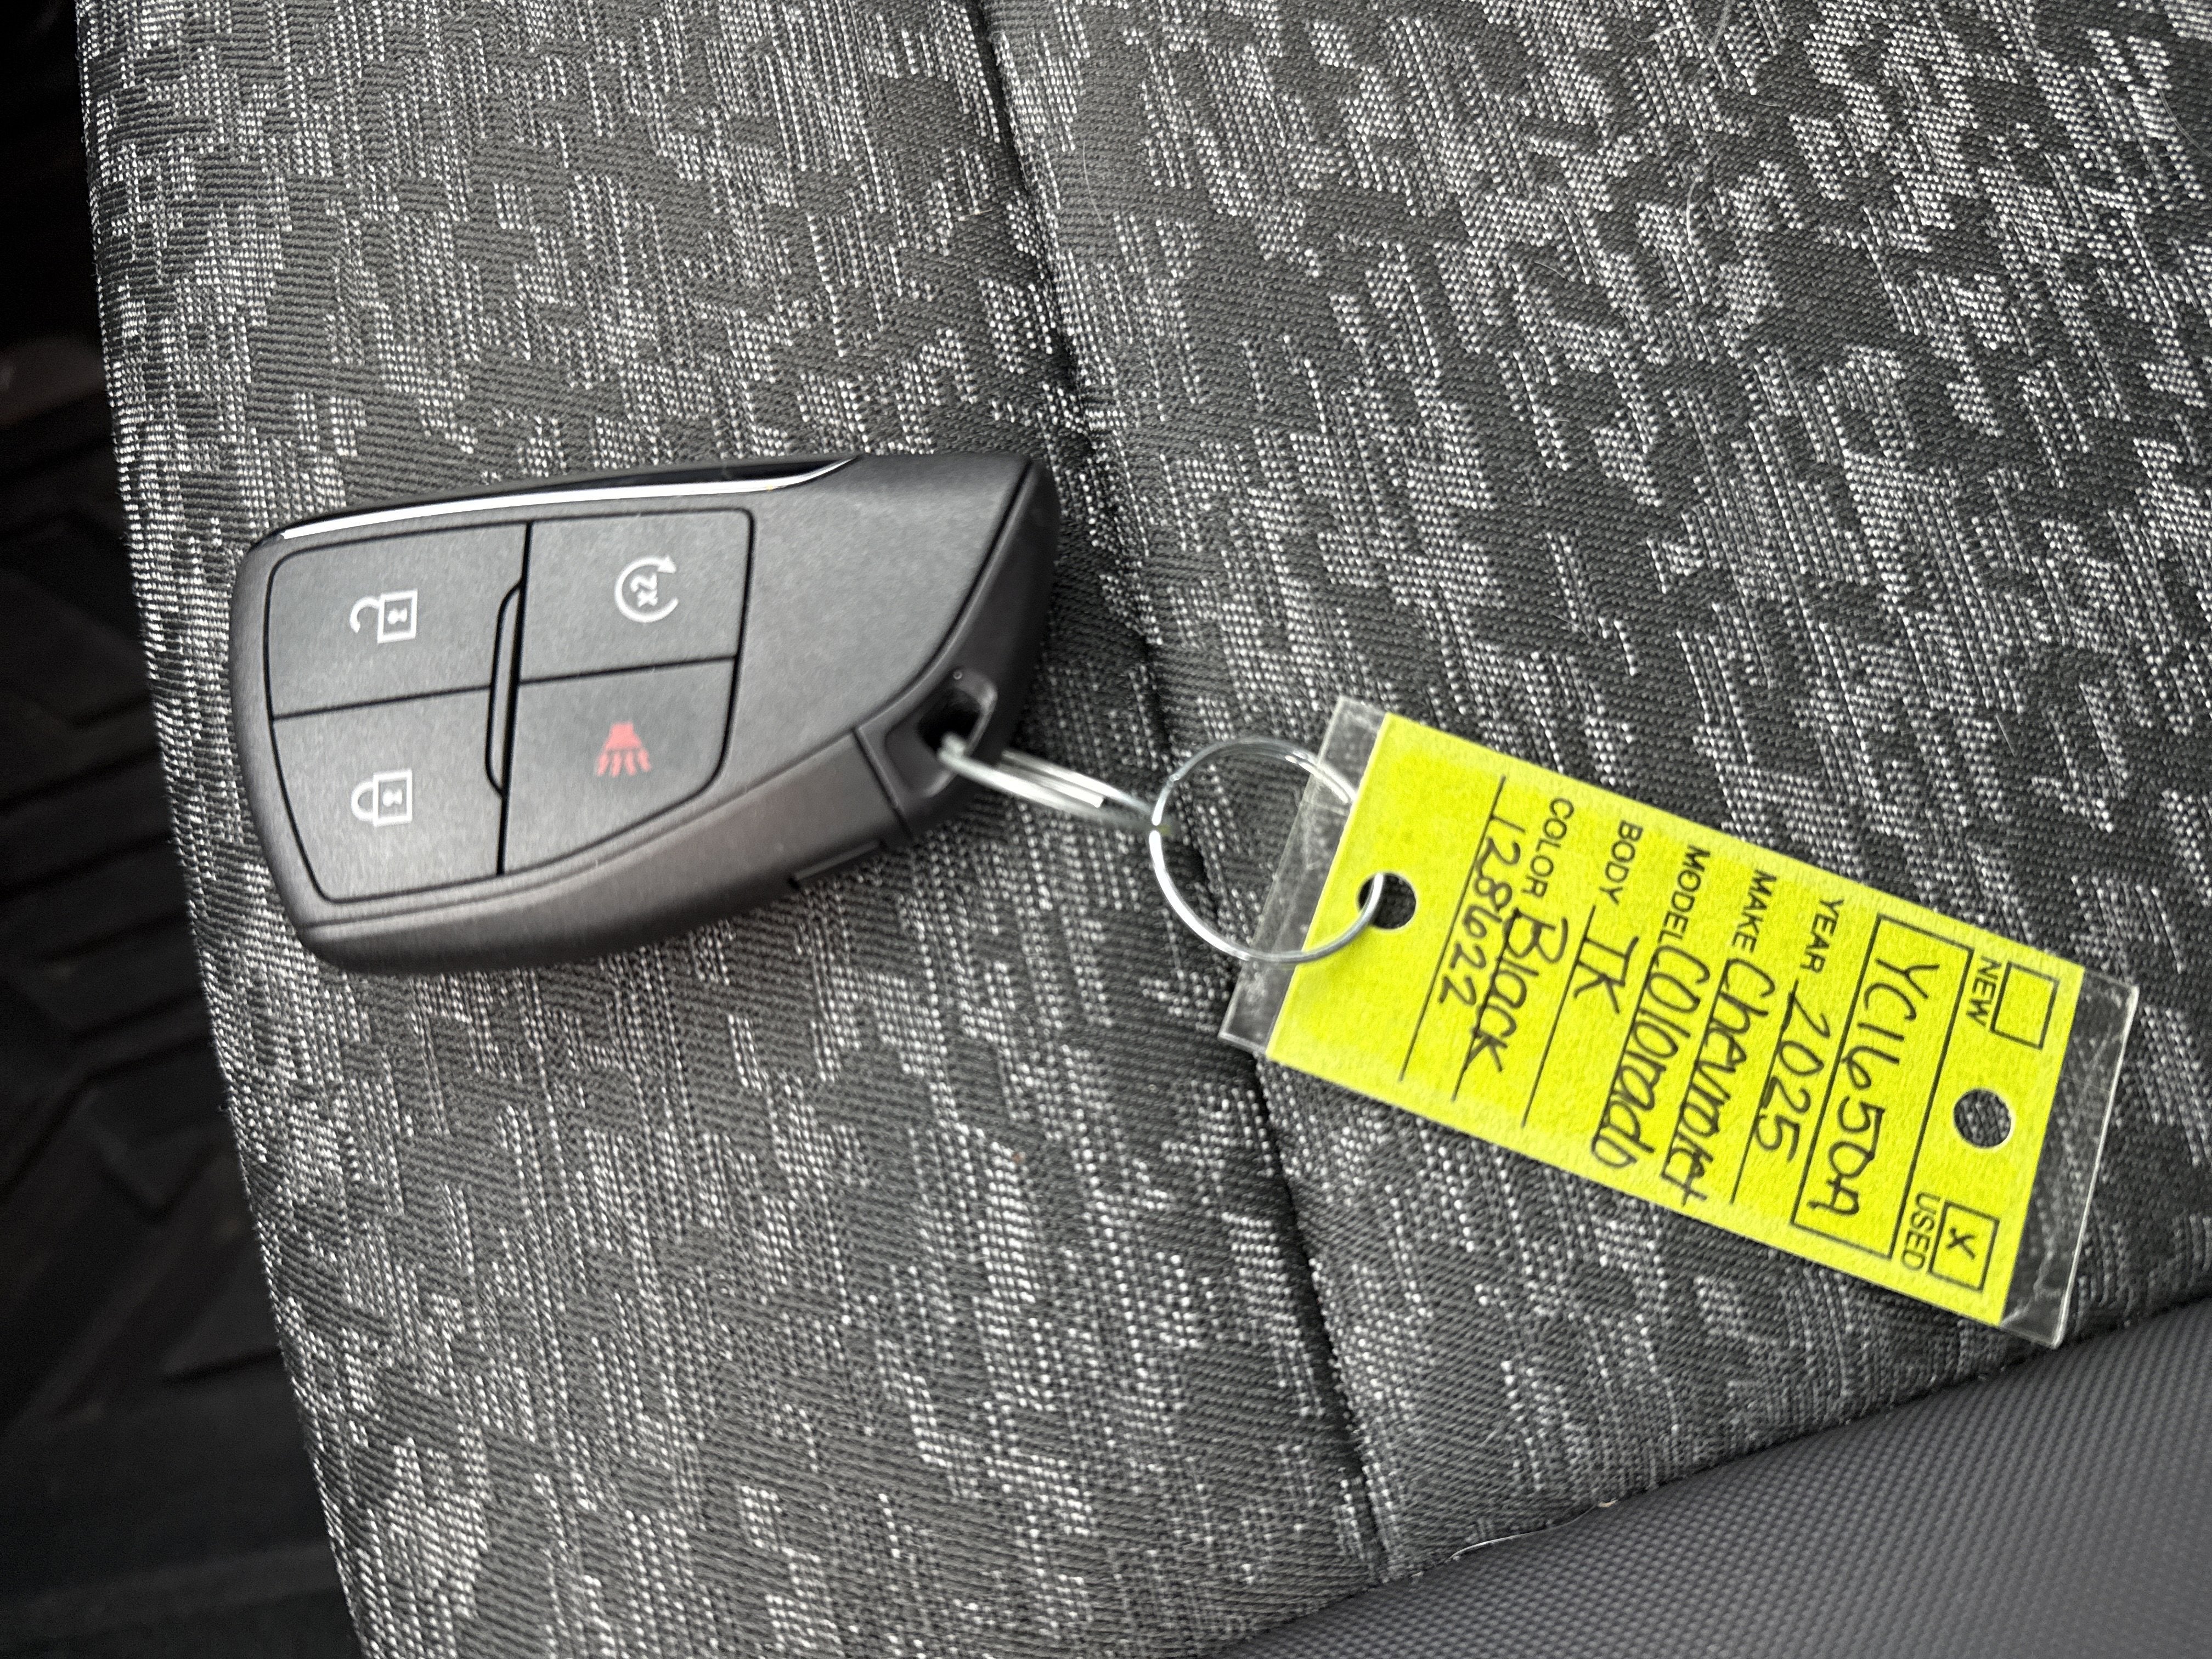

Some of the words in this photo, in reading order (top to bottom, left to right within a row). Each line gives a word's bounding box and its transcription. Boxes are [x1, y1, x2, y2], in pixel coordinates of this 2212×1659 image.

[1522, 797, 1575, 899] COLOR
[1599, 820, 1644, 905] BODY
[1658, 845, 1711, 944] MODEL
[1438, 814, 1526, 1005] 128622
[1731, 869, 1777, 953] MAKE
[1800, 898, 1844, 974] YEAR
[1464, 907, 1568, 1072] Black
[1573, 935, 1639, 1014] TK
[1966, 955, 2002, 1027] NEW
[1592, 944, 1711, 1170] Colorado
[1661, 957, 1776, 1206] Chevrolet
[1754, 990, 1830, 1163] 2025
[1807, 957, 1940, 1216] YC1650A
[1900, 1191, 1940, 1271] USED
